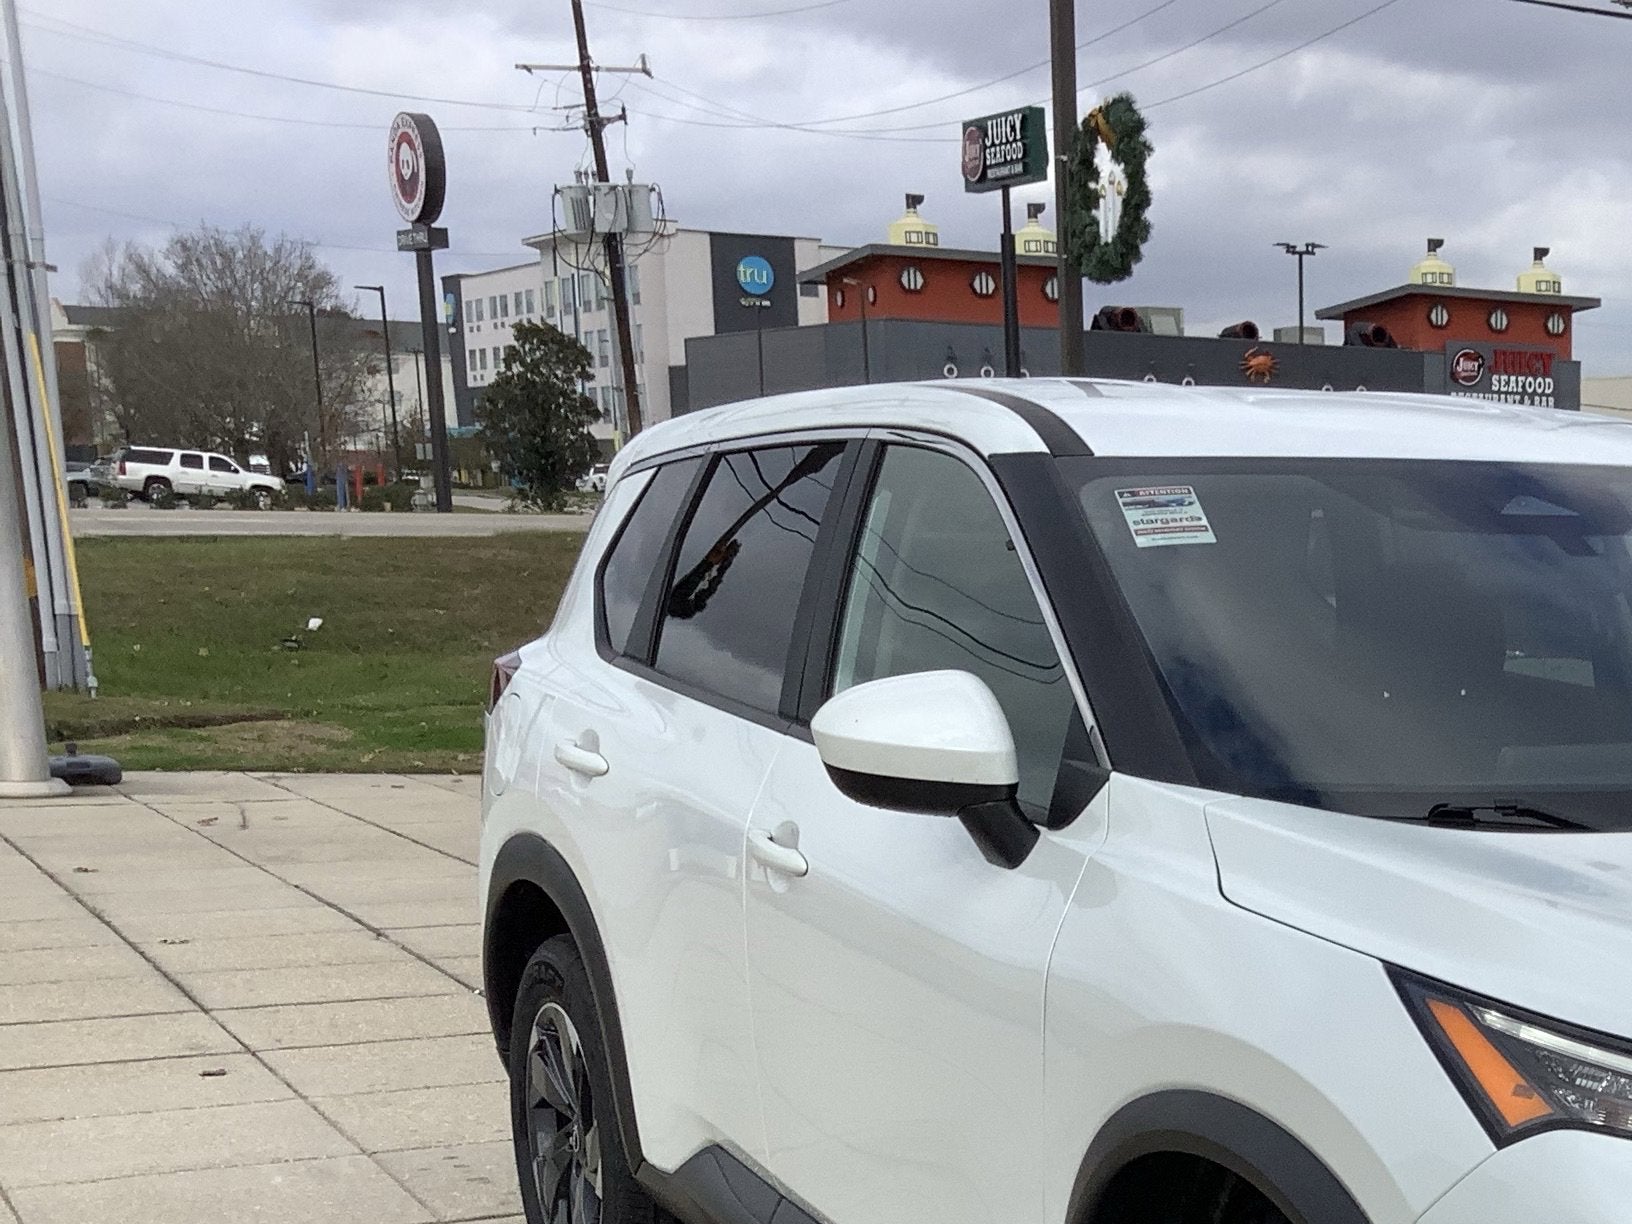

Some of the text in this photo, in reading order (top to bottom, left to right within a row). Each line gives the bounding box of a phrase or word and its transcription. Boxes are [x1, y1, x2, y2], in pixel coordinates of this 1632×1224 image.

[984, 113, 1022, 147] JUICY
[985, 141, 1024, 166] SEAFOOD
[738, 263, 767, 284] tru
[1488, 349, 1555, 377] JUICY
[1491, 374, 1554, 394] SEAFOOD
[1139, 488, 1189, 496] ATTENTION
